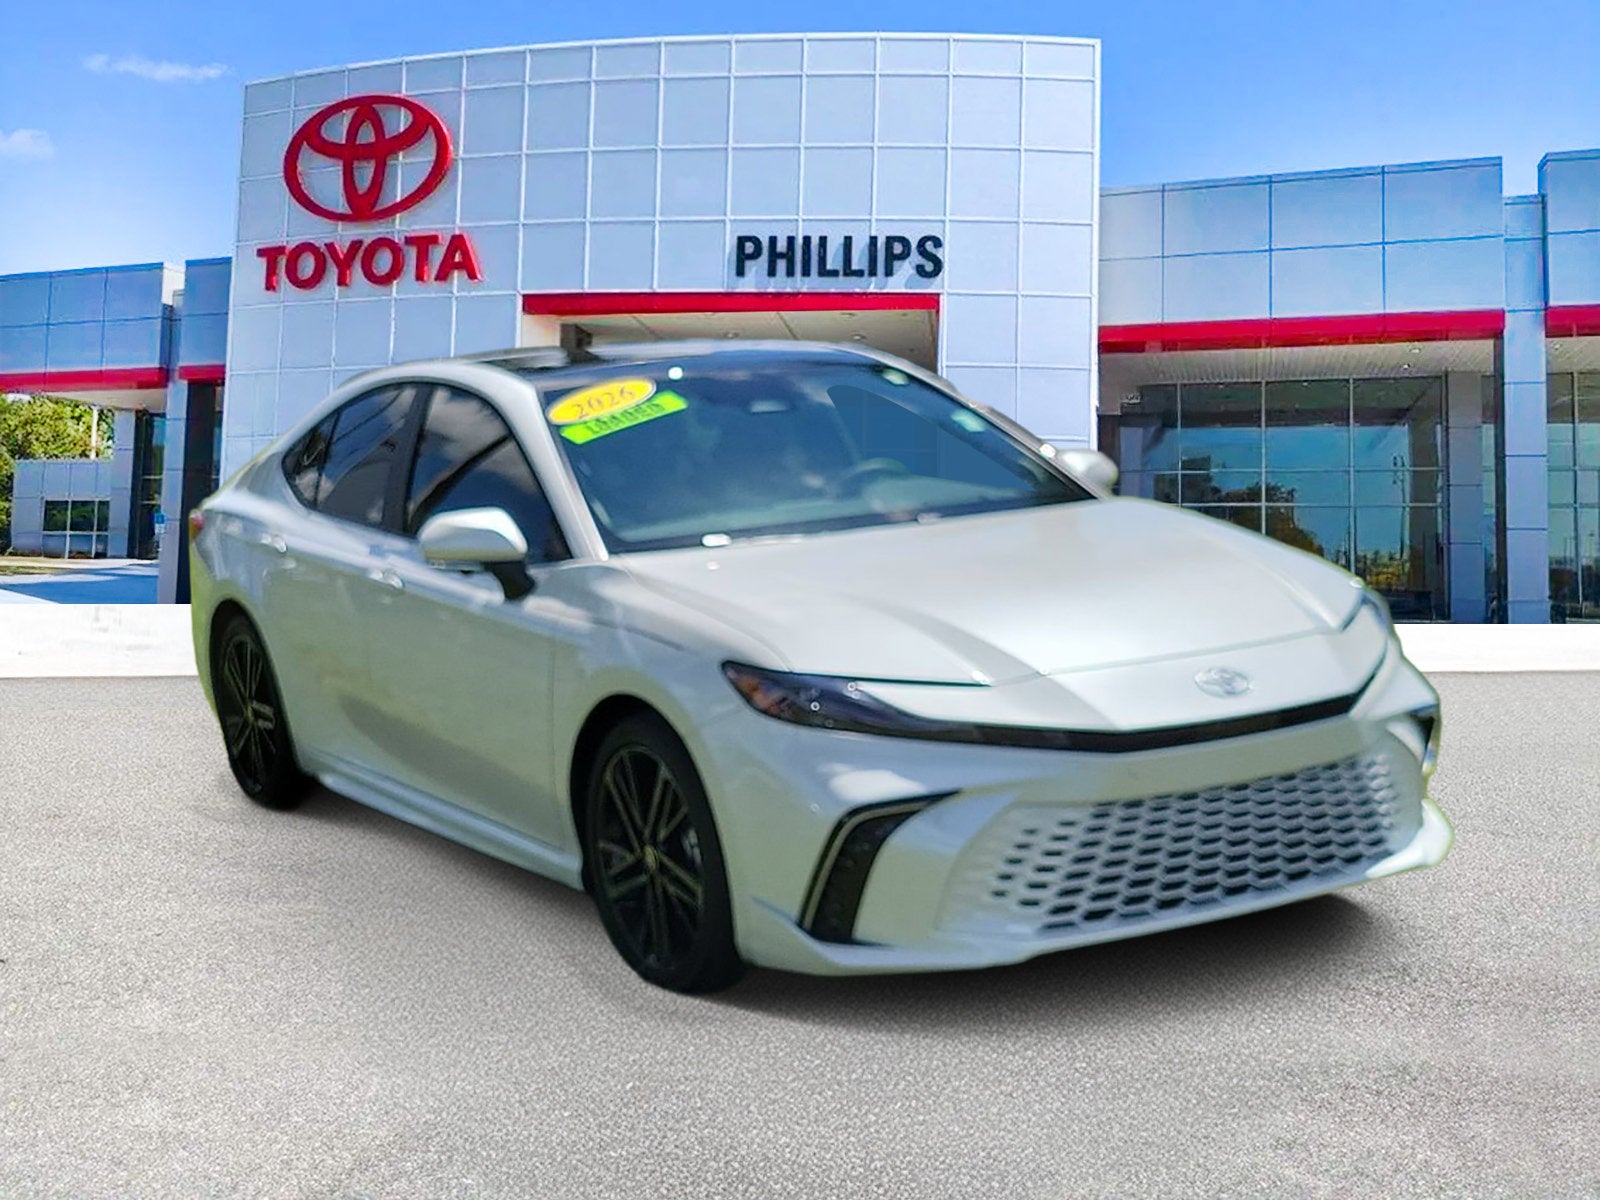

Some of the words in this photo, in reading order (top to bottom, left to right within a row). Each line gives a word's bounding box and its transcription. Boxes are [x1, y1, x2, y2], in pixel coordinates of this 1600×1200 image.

[256, 234, 482, 292] TOYOTA
[735, 235, 943, 279] PHILLIPS
[572, 385, 635, 420] 2026
